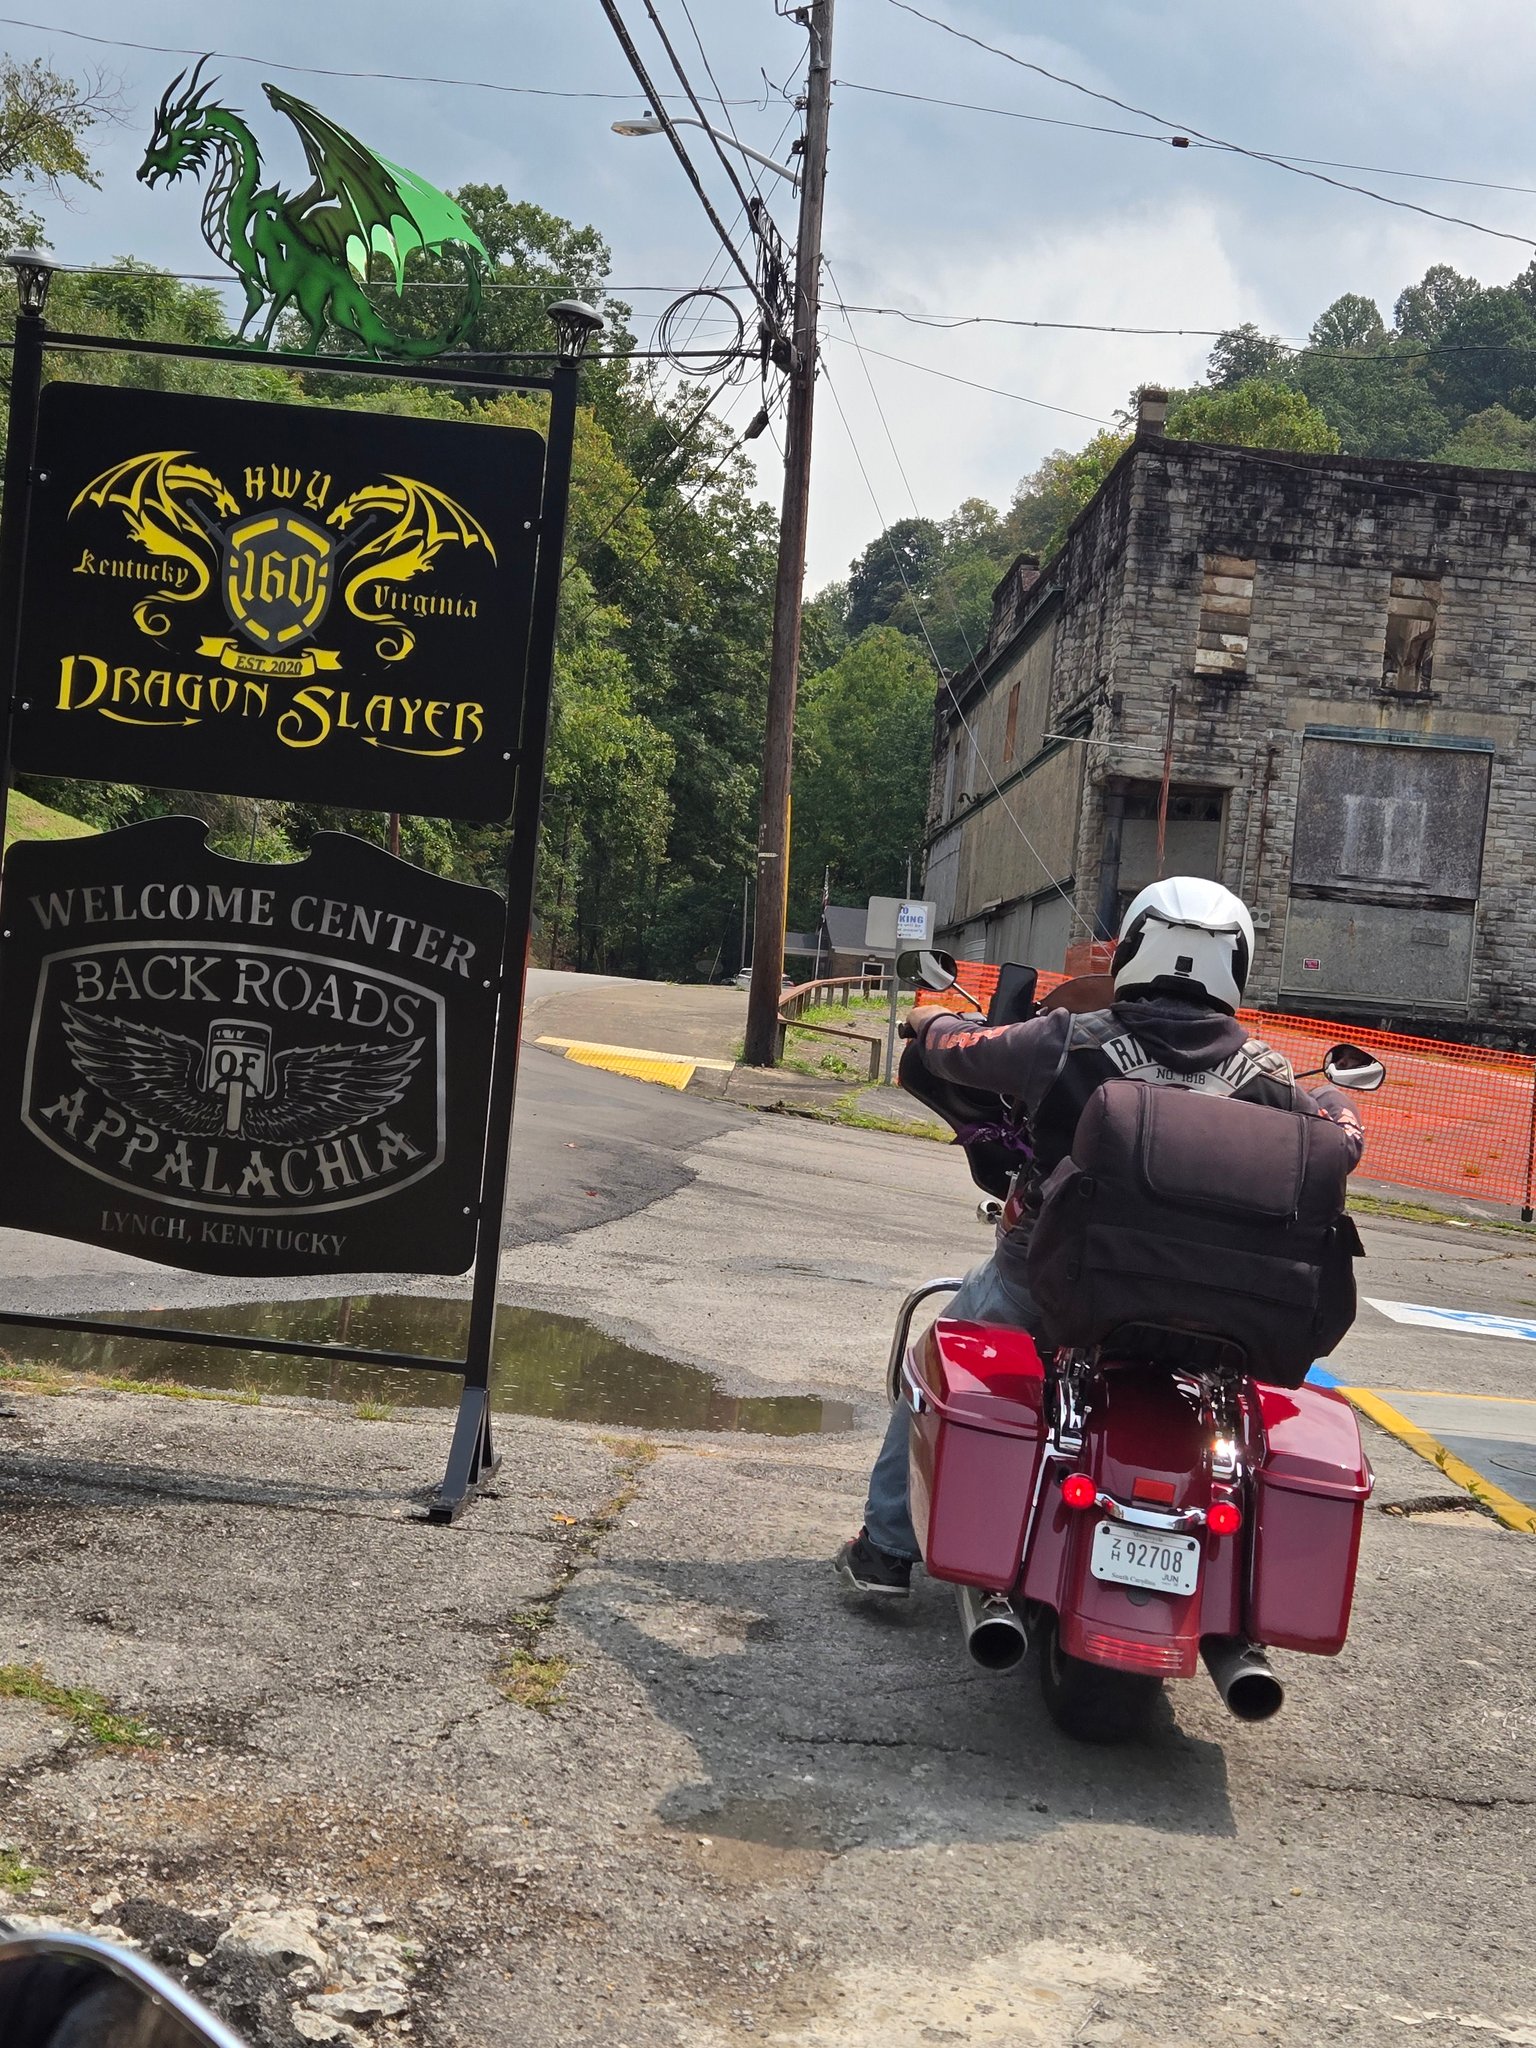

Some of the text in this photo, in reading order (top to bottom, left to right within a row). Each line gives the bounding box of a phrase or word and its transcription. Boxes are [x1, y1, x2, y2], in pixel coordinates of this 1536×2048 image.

[72, 549, 189, 588] Kentucky
[240, 549, 317, 608] 160
[373, 584, 478, 619] Virginia
[235, 655, 304, 675] EST. 2020
[55, 655, 484, 748] DRAGON SLAYER
[28, 883, 477, 979] WELCOME CENTER
[72, 955, 422, 1038] BACK ROADS
[214, 1049, 261, 1077] OF
[1156, 1067, 1206, 1085] NO. 1818
[40, 1086, 424, 1199] APPALACHIA
[101, 1209, 347, 1257] LYNCH, KENTUCKY
[1127, 1542, 1182, 1573] 92708
[1112, 1572, 1128, 1581] South
[1162, 1574, 1179, 1582] JUN
